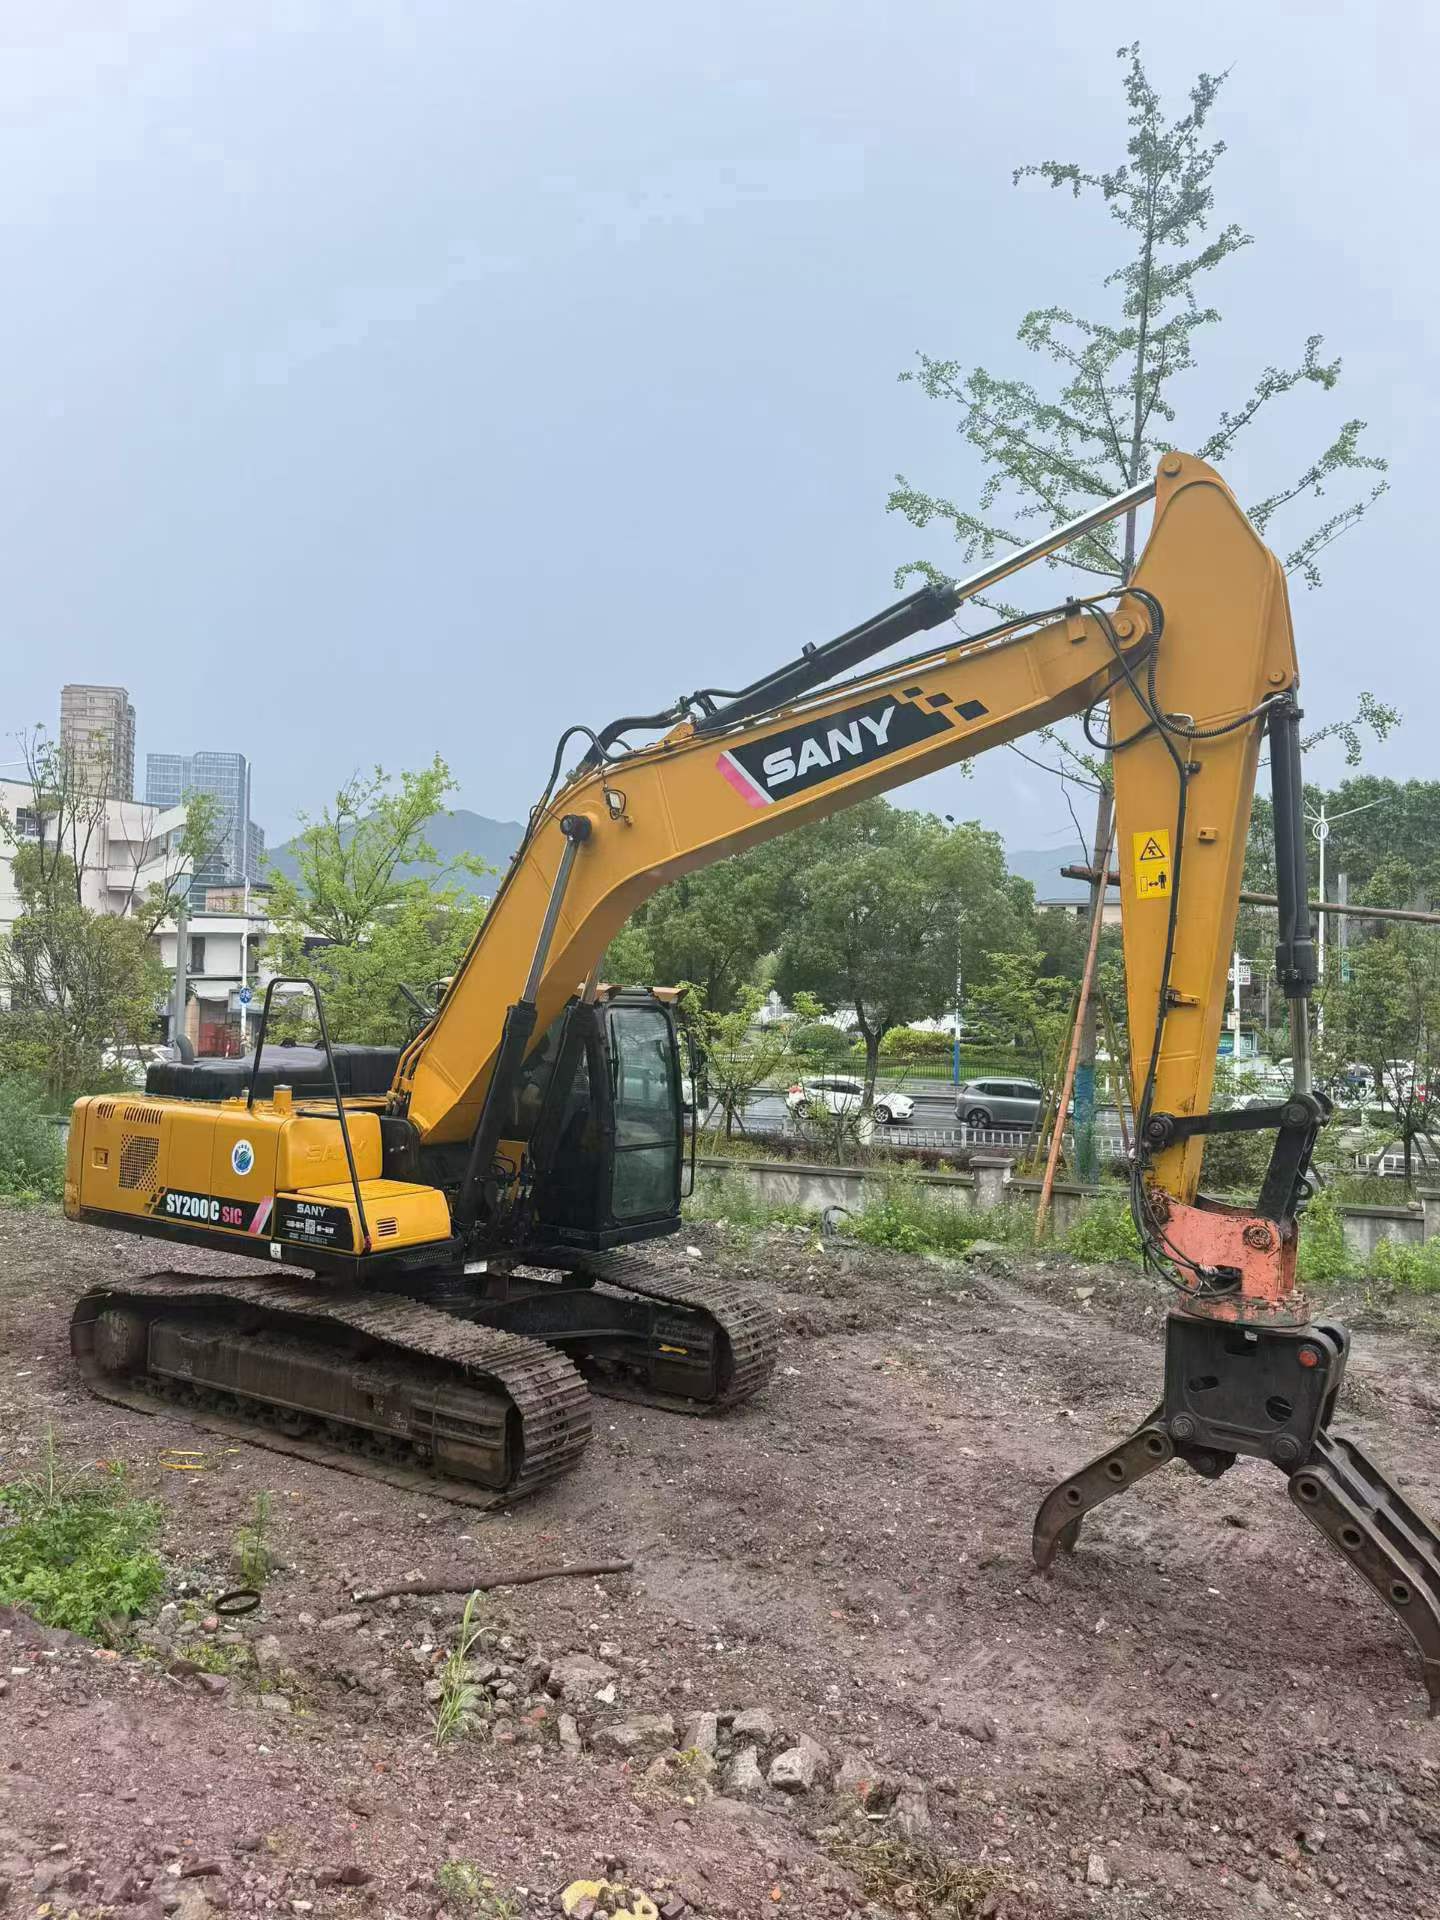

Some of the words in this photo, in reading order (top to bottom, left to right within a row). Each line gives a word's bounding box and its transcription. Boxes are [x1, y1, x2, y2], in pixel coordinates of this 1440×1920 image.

[763, 705, 895, 787] SANY
[166, 1193, 220, 1221] SY200C
[296, 1203, 327, 1217] SANY
